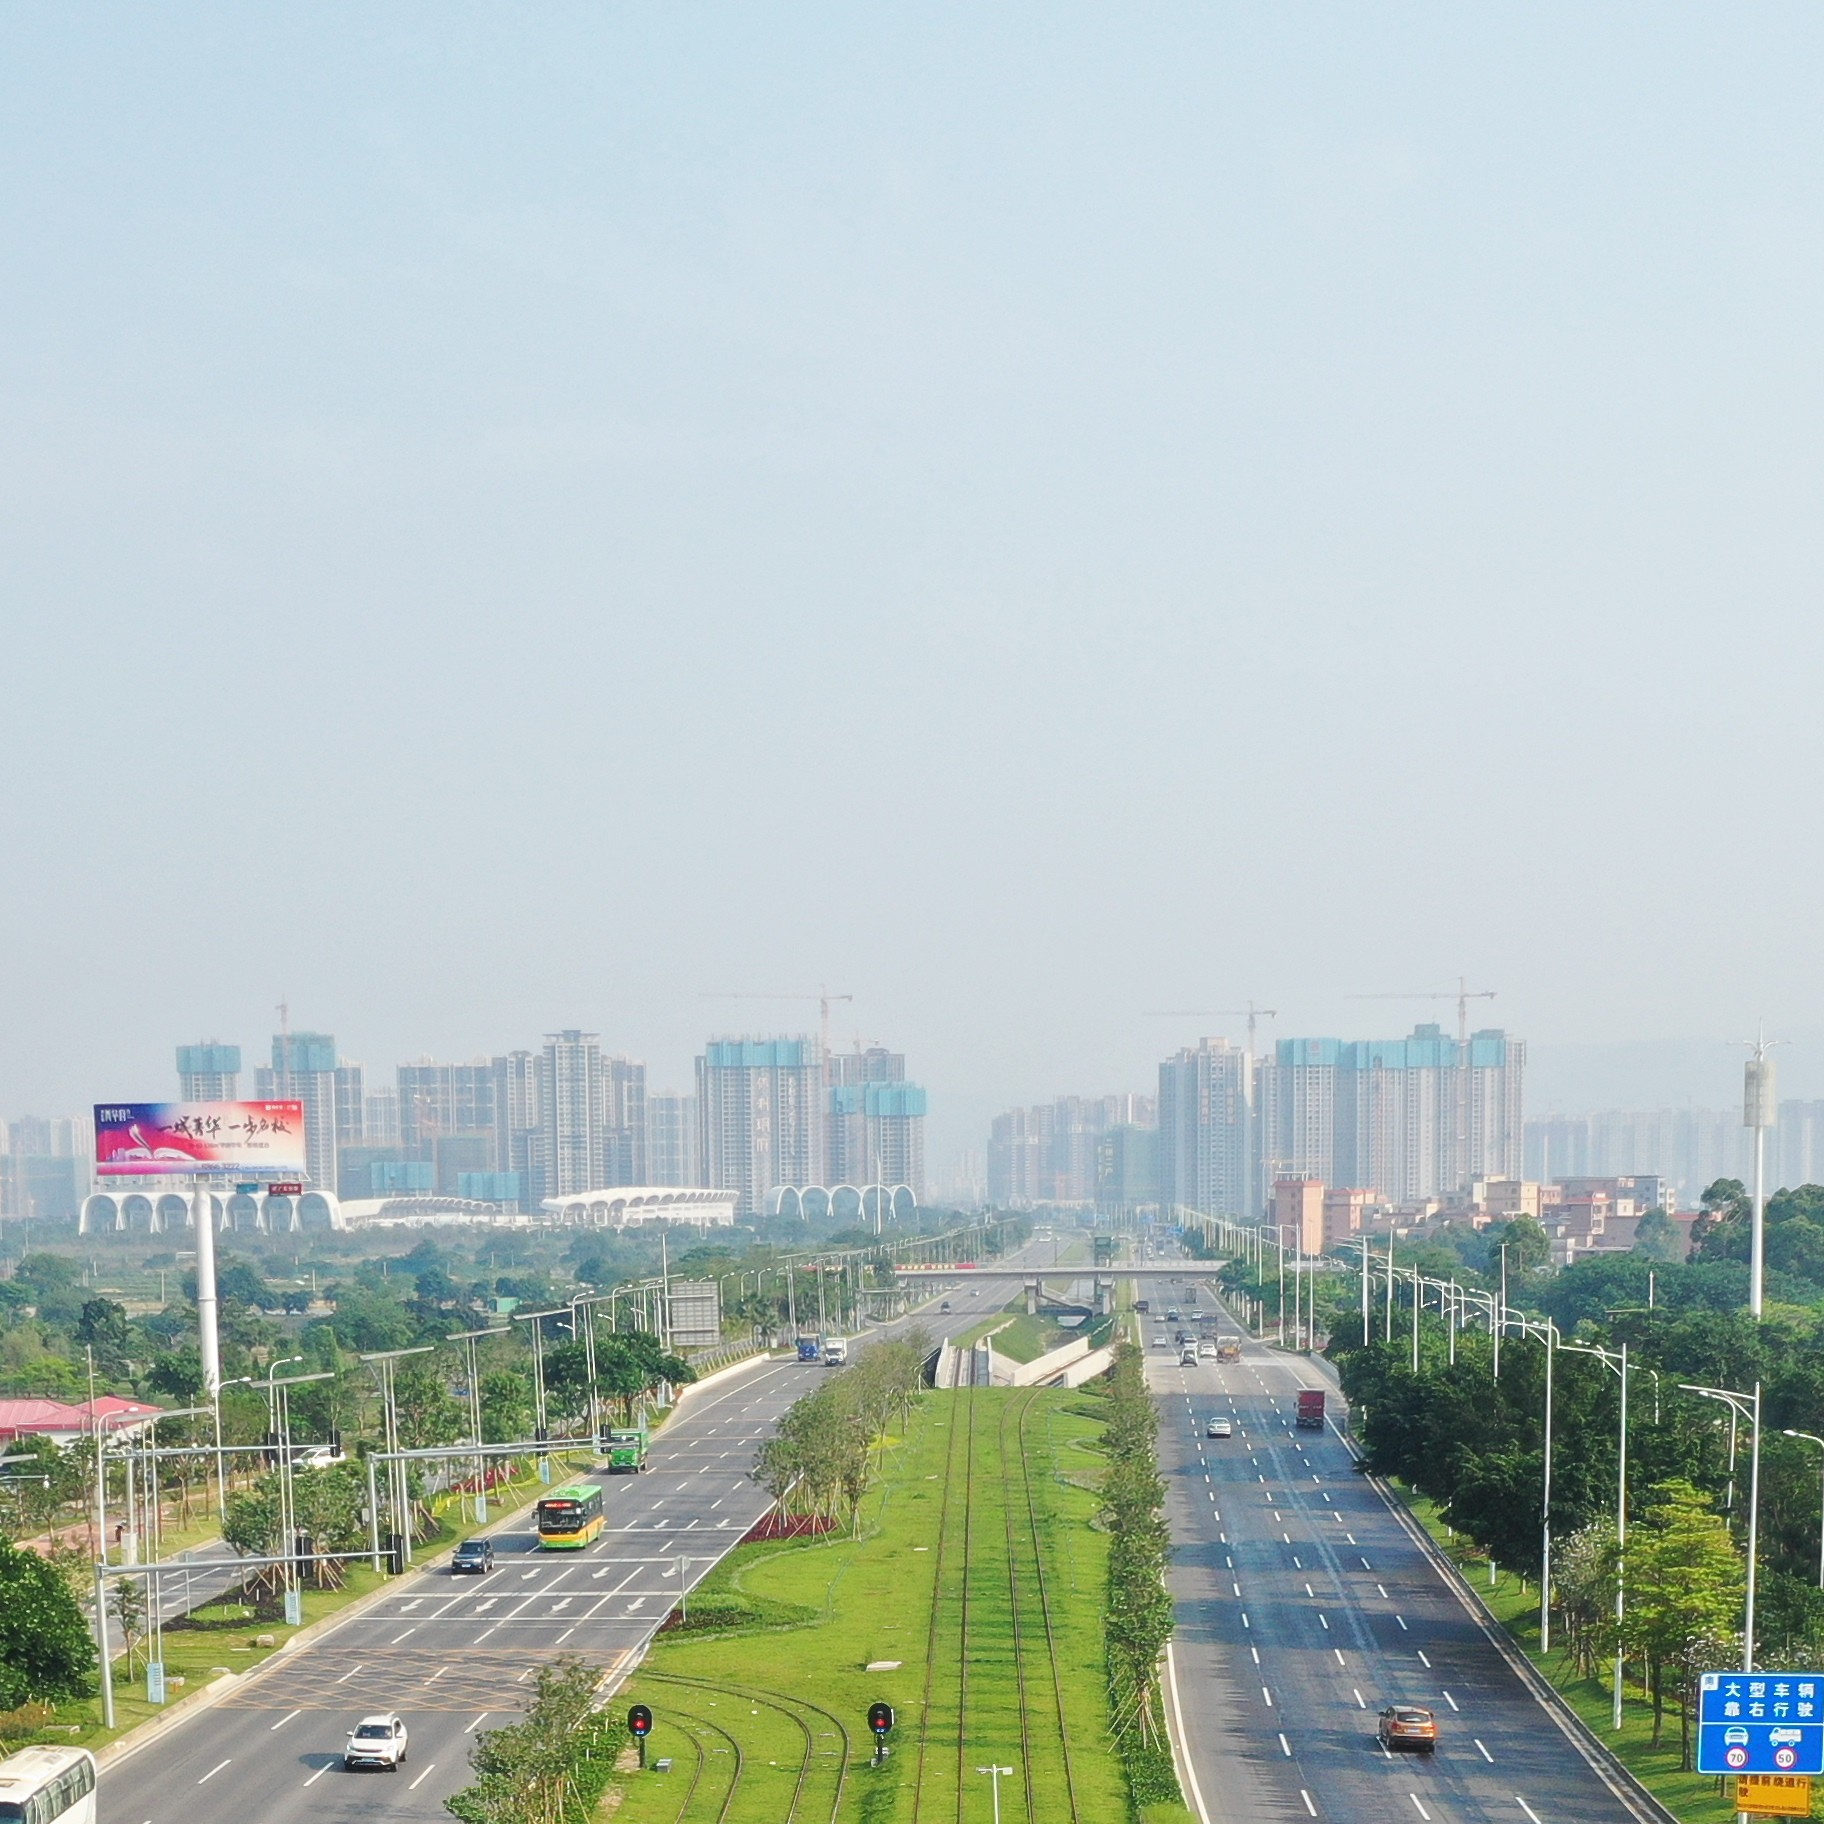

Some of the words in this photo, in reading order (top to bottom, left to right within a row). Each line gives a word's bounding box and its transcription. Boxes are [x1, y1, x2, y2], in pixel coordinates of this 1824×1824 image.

[1724, 1681, 1815, 1698] 大型车辆
[1723, 1701, 1814, 1717] 靠右行驶
[1731, 1753, 1743, 1763] 70
[1778, 1753, 1792, 1763] 50
